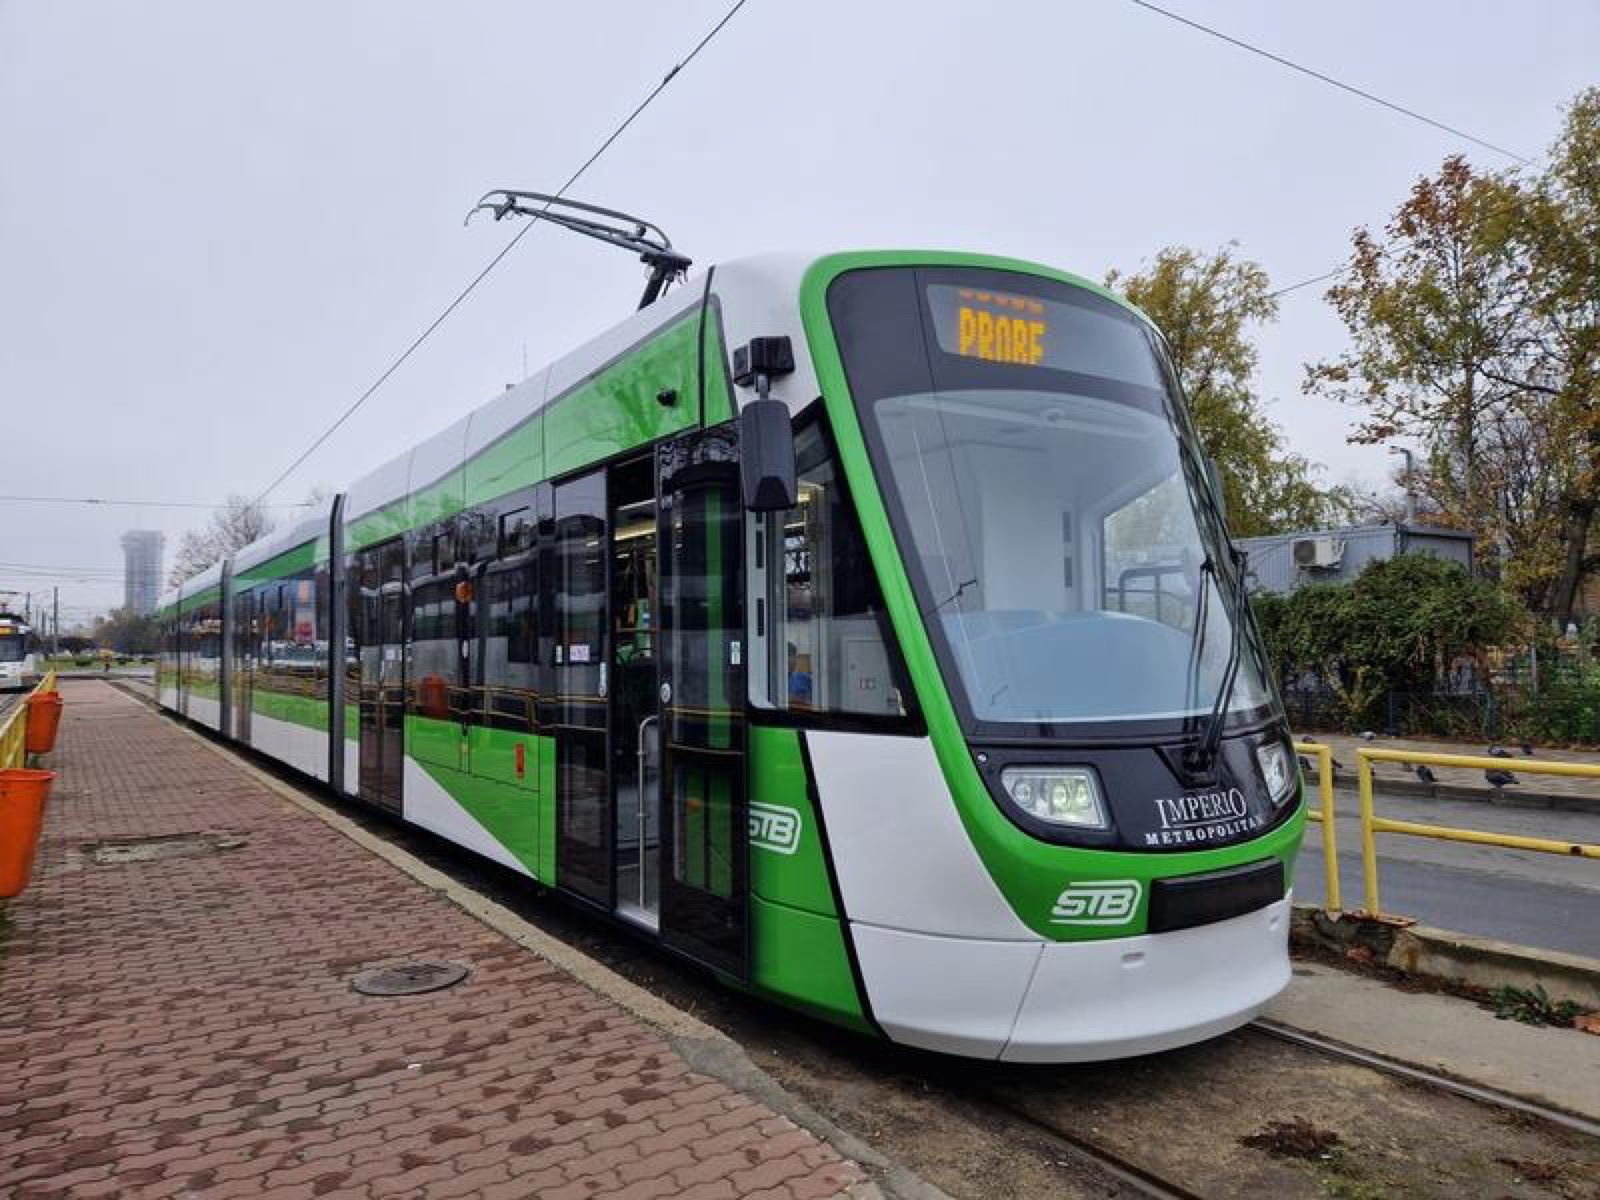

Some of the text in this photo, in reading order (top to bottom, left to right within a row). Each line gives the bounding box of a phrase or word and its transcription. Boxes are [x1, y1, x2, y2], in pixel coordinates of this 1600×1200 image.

[1156, 787, 1247, 829] IMPERIO
[1145, 815, 1265, 845] METROPOLITAN
[1052, 888, 1135, 918] STB
